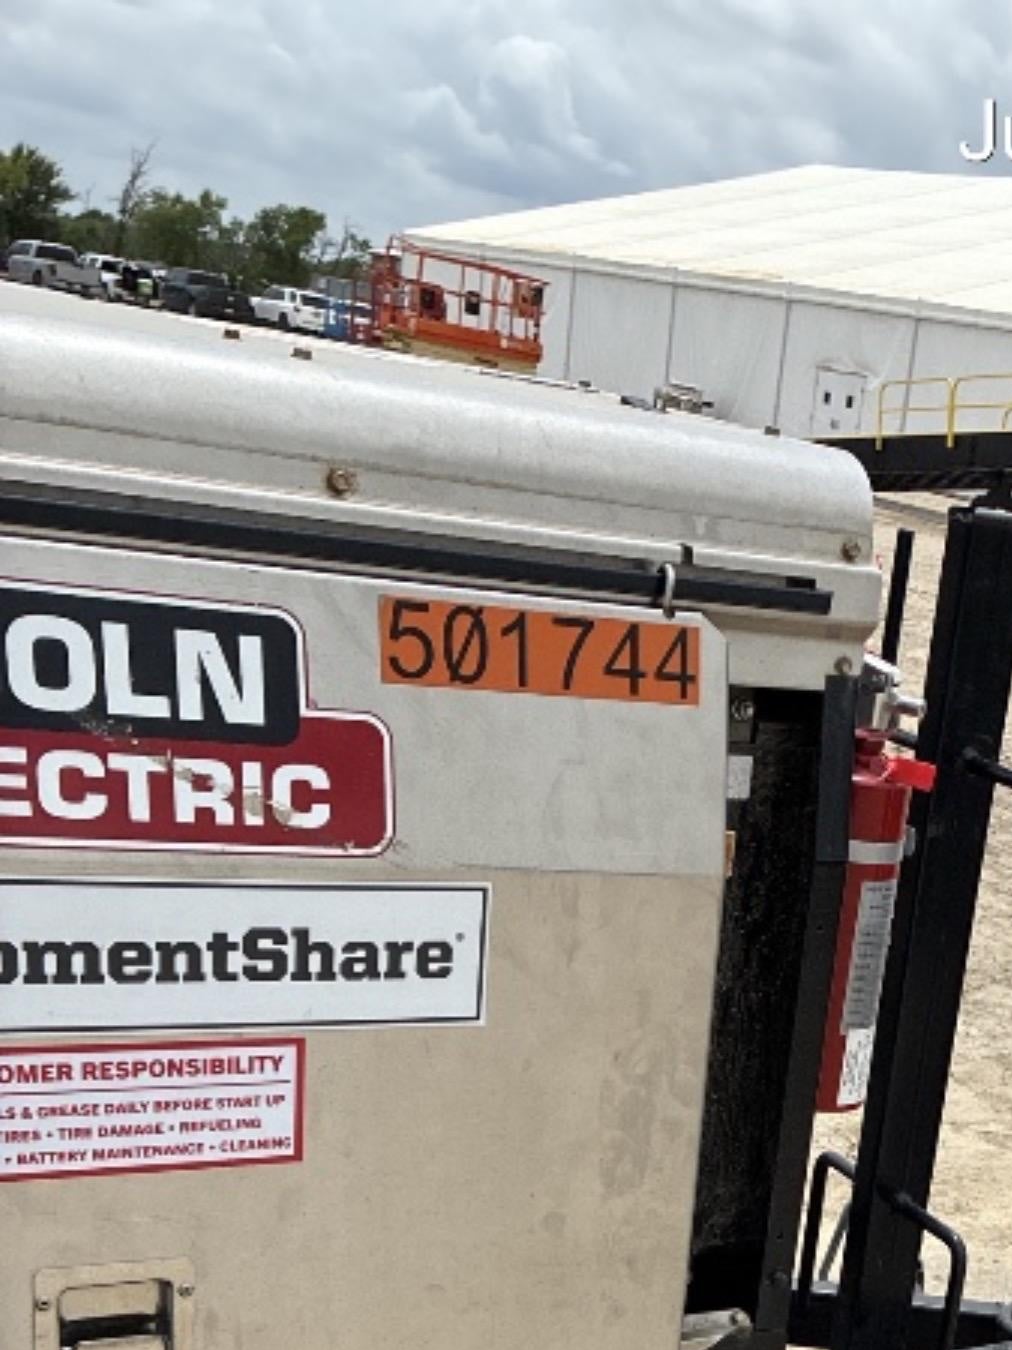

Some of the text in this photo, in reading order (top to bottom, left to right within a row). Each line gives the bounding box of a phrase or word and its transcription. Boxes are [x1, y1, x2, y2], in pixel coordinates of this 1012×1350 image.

[388, 599, 697, 700] 501744
[4, 613, 265, 727] OLN
[81, 1055, 285, 1081] RESPONSIBILITY
[37, 1103, 100, 1118] GREASE
[104, 1101, 150, 1116] DAILY
[152, 1098, 213, 1114] BEFORE
[215, 1095, 262, 1110] START
[266, 1094, 286, 1108] UP
[98, 1122, 165, 1138] DAMAGE
[179, 1118, 262, 1134] REFUELING
[17, 1137, 292, 1165] BATTERY MAINTENANCE CLEANING
